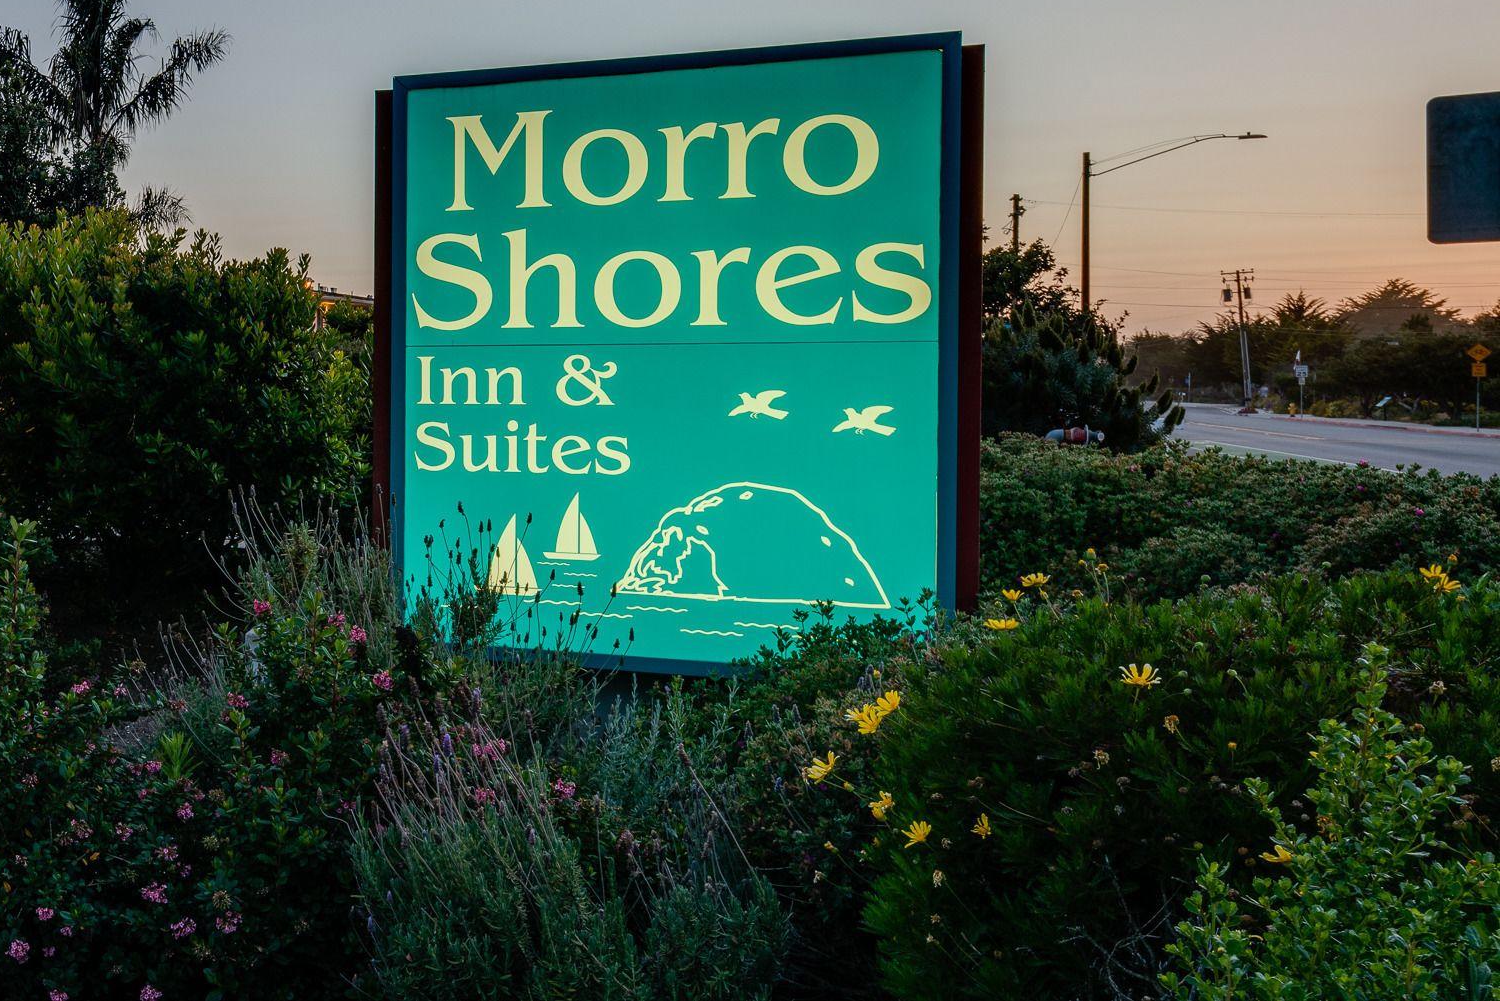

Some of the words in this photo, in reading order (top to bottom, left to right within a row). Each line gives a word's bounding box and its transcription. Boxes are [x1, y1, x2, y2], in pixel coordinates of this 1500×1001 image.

[446, 110, 880, 212] Morro
[412, 228, 932, 331] Shores
[416, 356, 527, 406] Inn
[556, 354, 618, 406] &
[415, 420, 631, 475] Suites
